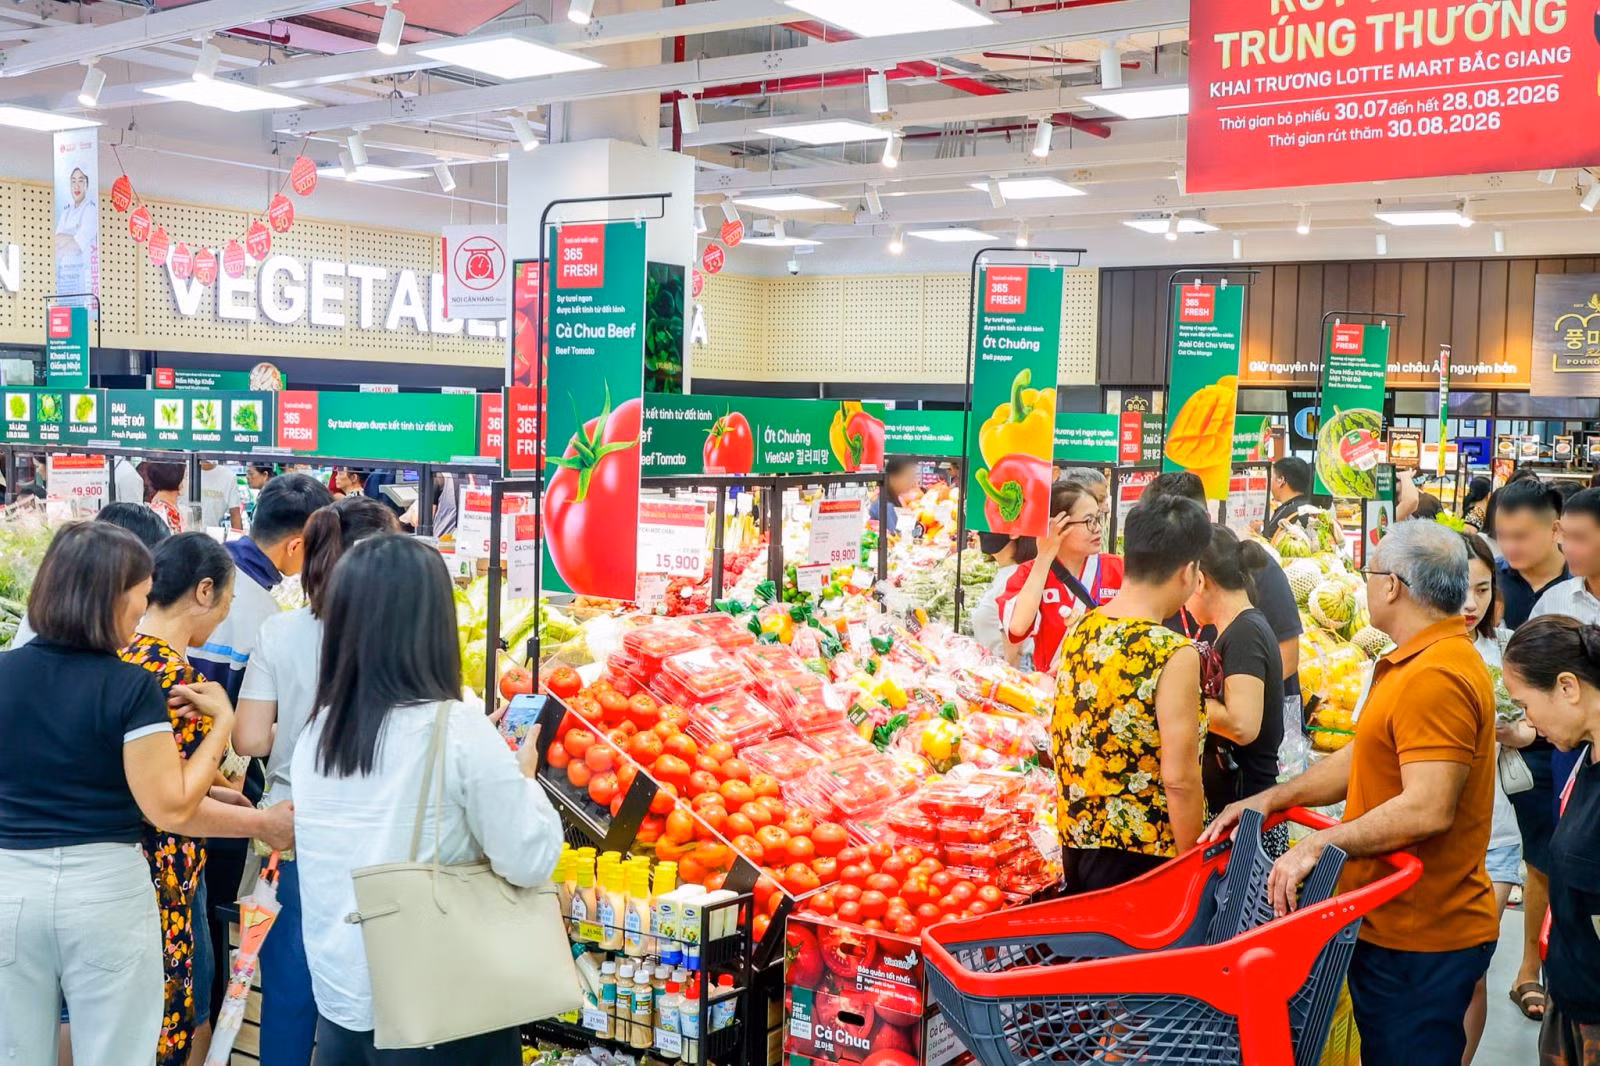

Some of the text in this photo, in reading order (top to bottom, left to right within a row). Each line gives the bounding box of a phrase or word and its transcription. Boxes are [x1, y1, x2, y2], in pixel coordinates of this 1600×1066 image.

[1213, 15, 1357, 70] TRÚNG
[1210, 46, 1572, 98] KHAI TRƯƠNG LOTTE MART BẮC GIANG
[1219, 83, 1560, 131] Thời gian bỏ phiếu 30.07 đến hết 28.08.2026
[1268, 112, 1501, 148] Thời gian rút thăm 30.08.2026
[563, 247, 583, 260] 365
[563, 263, 598, 277] FRESH
[991, 283, 1009, 293] 365
[990, 295, 1021, 305] FRESH
[1184, 307, 1209, 316] FRESH
[556, 322, 636, 338] Cà Chua Beef
[982, 334, 1040, 352] Ớt Chuông
[555, 346, 595, 355] Beef Tomato
[1269, 361, 1308, 375] nguyên
[1402, 361, 1430, 373] châu
[1449, 361, 1493, 376] nguyên
[283, 412, 300, 425] 365
[645, 406, 659, 420] kết
[674, 408, 685, 420] từ
[684, 407, 697, 420] đất
[697, 408, 713, 421] lành
[283, 427, 313, 440] FRESH
[764, 425, 811, 447] Ớt Chuông
[655, 452, 687, 465] Tomato
[764, 451, 795, 464] VietGAP
[656, 553, 699, 571] 15,900
[831, 549, 856, 562] 59,900
[886, 971, 896, 980] tốt
[895, 974, 911, 984] nhất
[814, 1024, 871, 1050] Cà Chua
